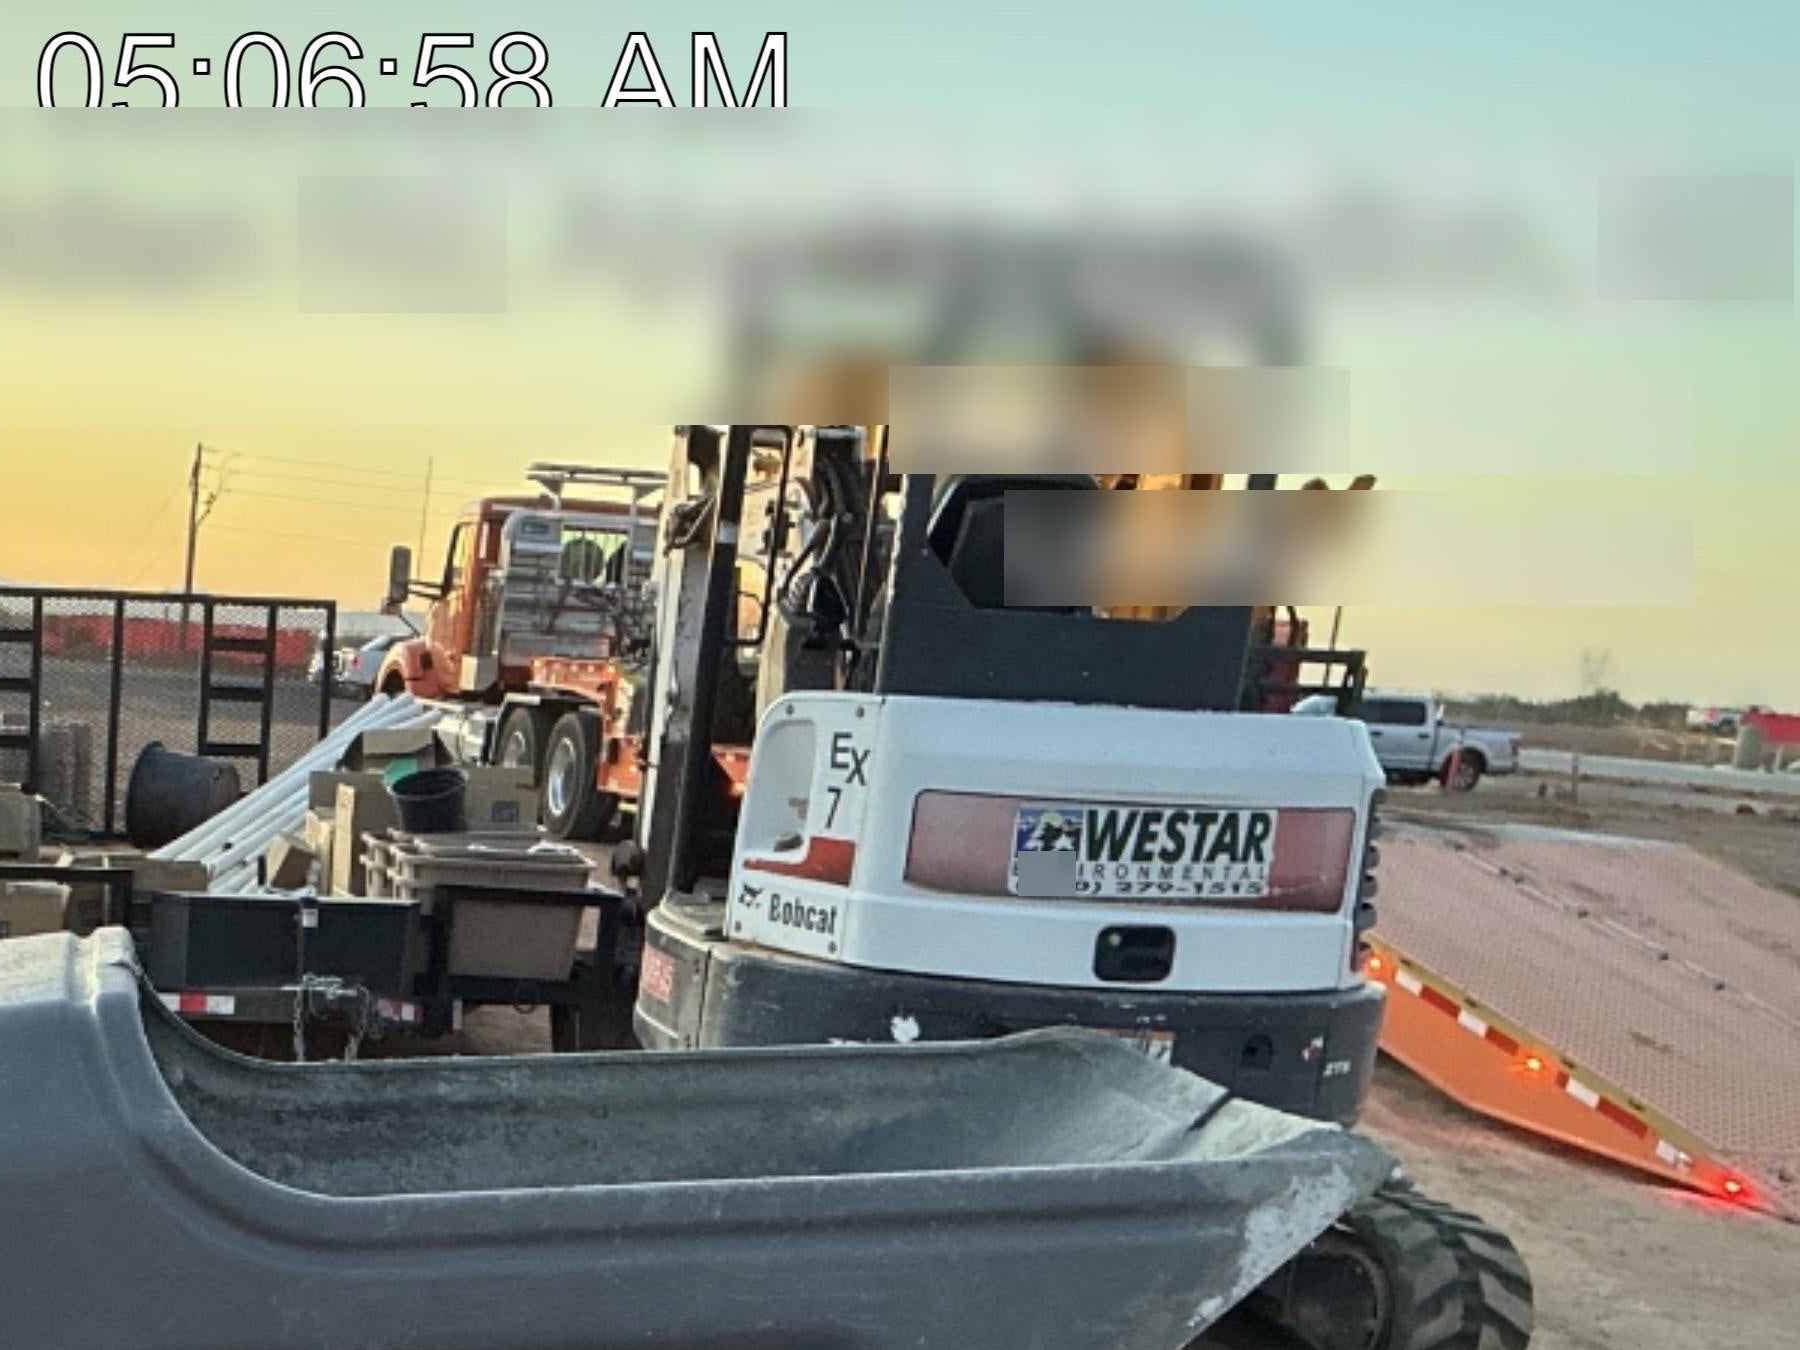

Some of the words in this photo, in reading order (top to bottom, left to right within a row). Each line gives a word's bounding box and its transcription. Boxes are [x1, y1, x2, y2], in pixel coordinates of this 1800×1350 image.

[830, 731, 871, 787] EX
[824, 785, 842, 830] 7
[1085, 809, 1271, 863] WESTAR
[768, 893, 838, 935] Bobcat
